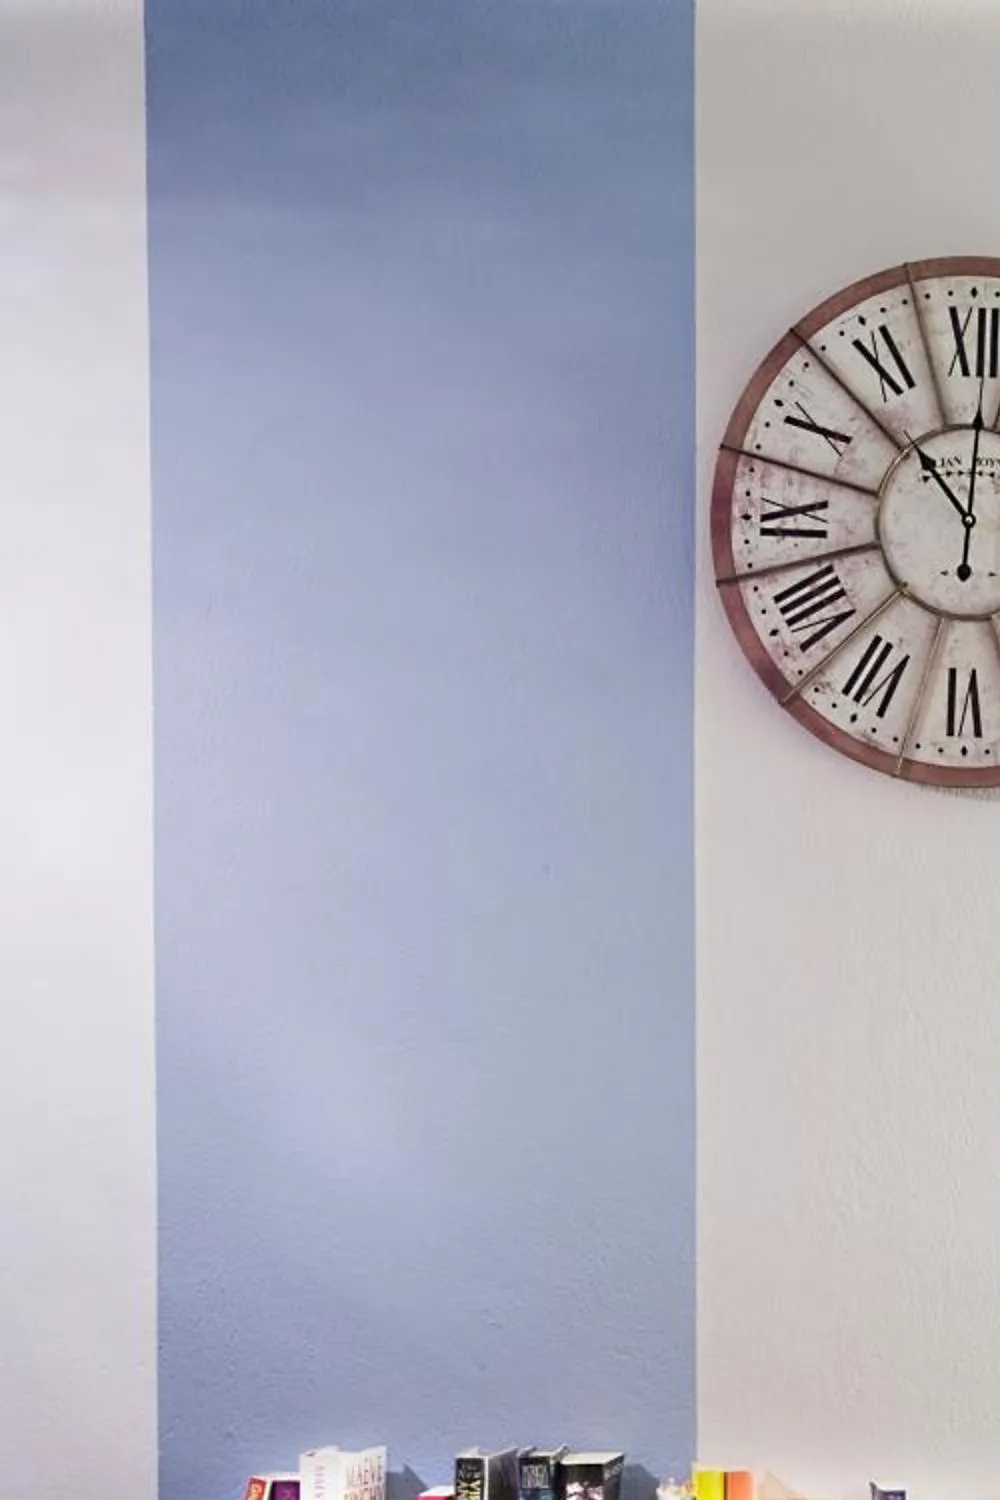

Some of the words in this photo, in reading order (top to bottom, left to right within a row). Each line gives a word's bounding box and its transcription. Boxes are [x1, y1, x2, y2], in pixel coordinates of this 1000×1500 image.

[851, 323, 917, 402] XI
[948, 306, 1000, 378] XII
[783, 401, 853, 457] X
[759, 497, 829, 539] IX
[841, 634, 911, 718] VII
[946, 666, 983, 739] VI
